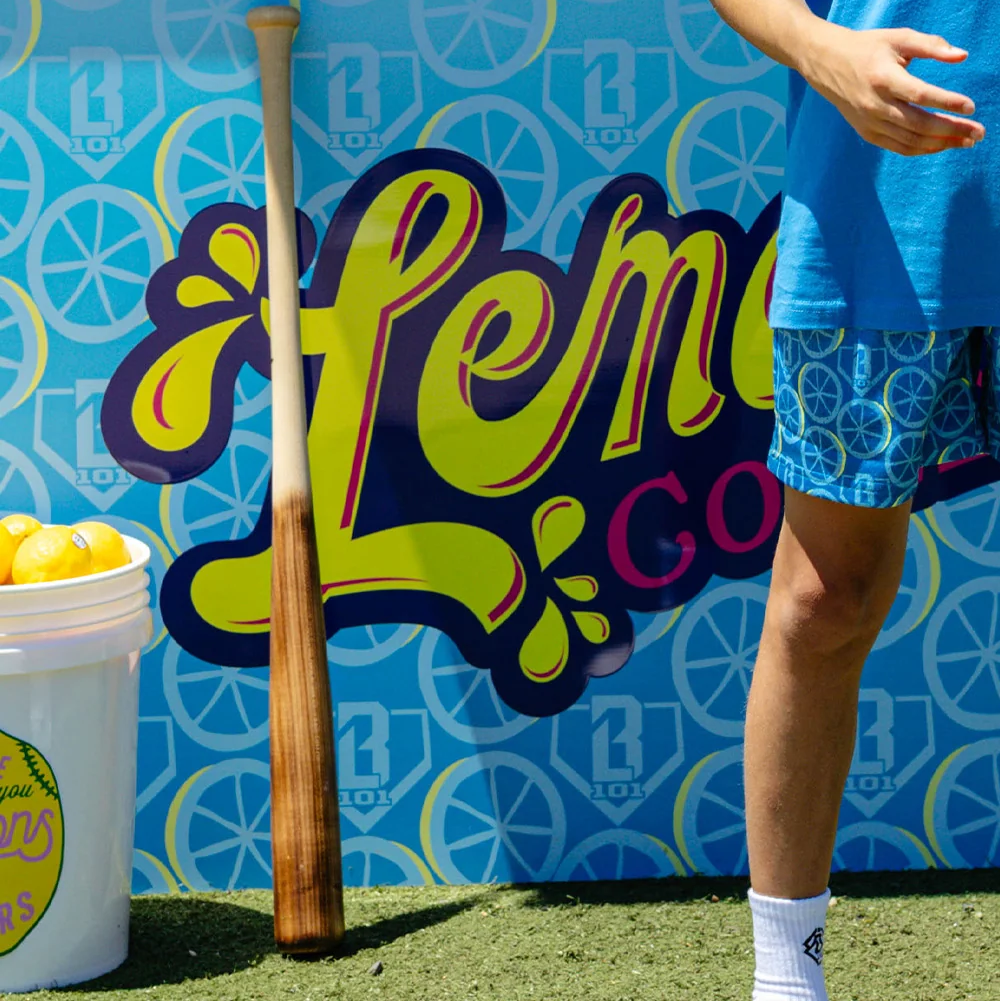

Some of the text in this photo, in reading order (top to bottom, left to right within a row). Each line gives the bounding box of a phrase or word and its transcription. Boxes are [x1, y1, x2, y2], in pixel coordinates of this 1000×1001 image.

[69, 135, 127, 154] 101
[326, 132, 383, 151] 101
[583, 127, 638, 146] 101
[338, 788, 393, 806] 101
[590, 782, 646, 799] 101
